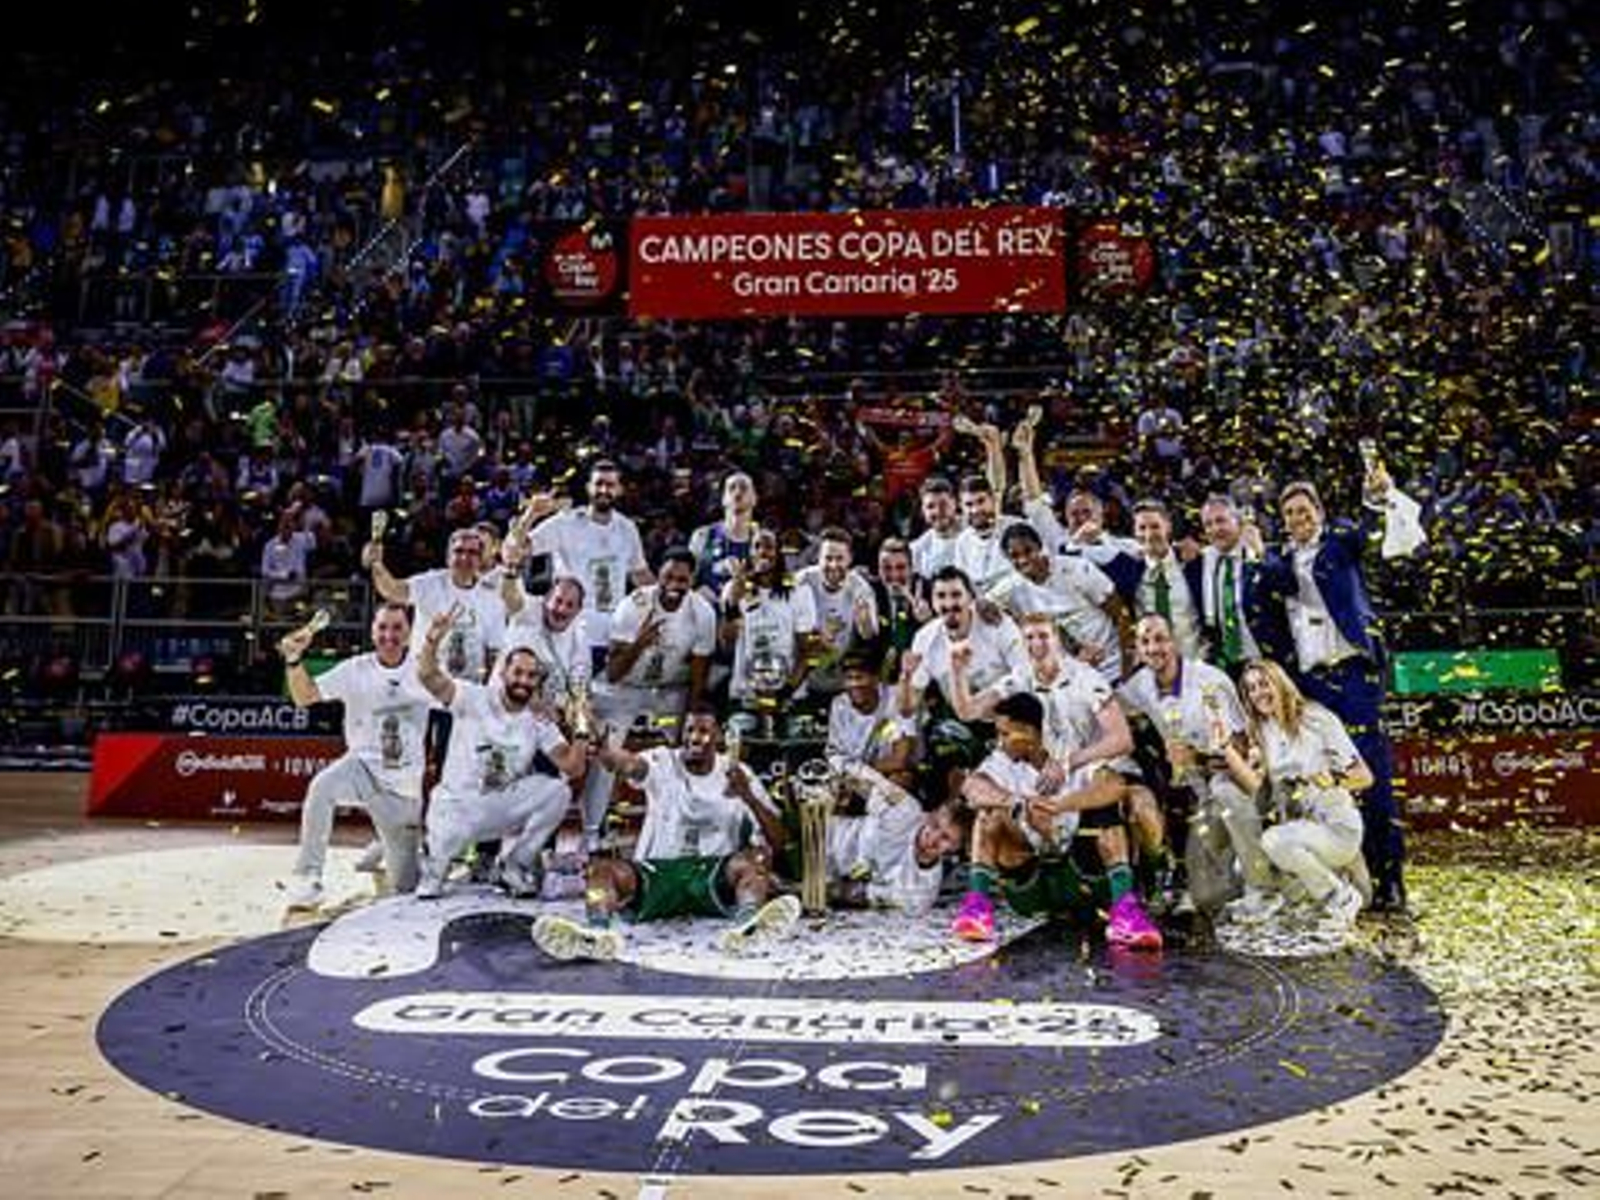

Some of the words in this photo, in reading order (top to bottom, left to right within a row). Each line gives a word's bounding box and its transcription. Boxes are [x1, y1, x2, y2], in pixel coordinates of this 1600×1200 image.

[638, 233, 834, 263] CAMPEONES
[838, 230, 927, 260] COPA
[931, 228, 990, 257] DEL
[997, 224, 1054, 257] REY
[732, 271, 801, 296] Gran
[805, 267, 917, 294] Canaria
[921, 268, 959, 292] '25
[171, 703, 310, 731] #CopaACB
[394, 1004, 602, 1026] Gran
[629, 1007, 992, 1032] Canaria
[471, 1047, 928, 1093] Copa
[468, 1092, 649, 1121] del
[656, 1098, 1003, 1160] Rey
